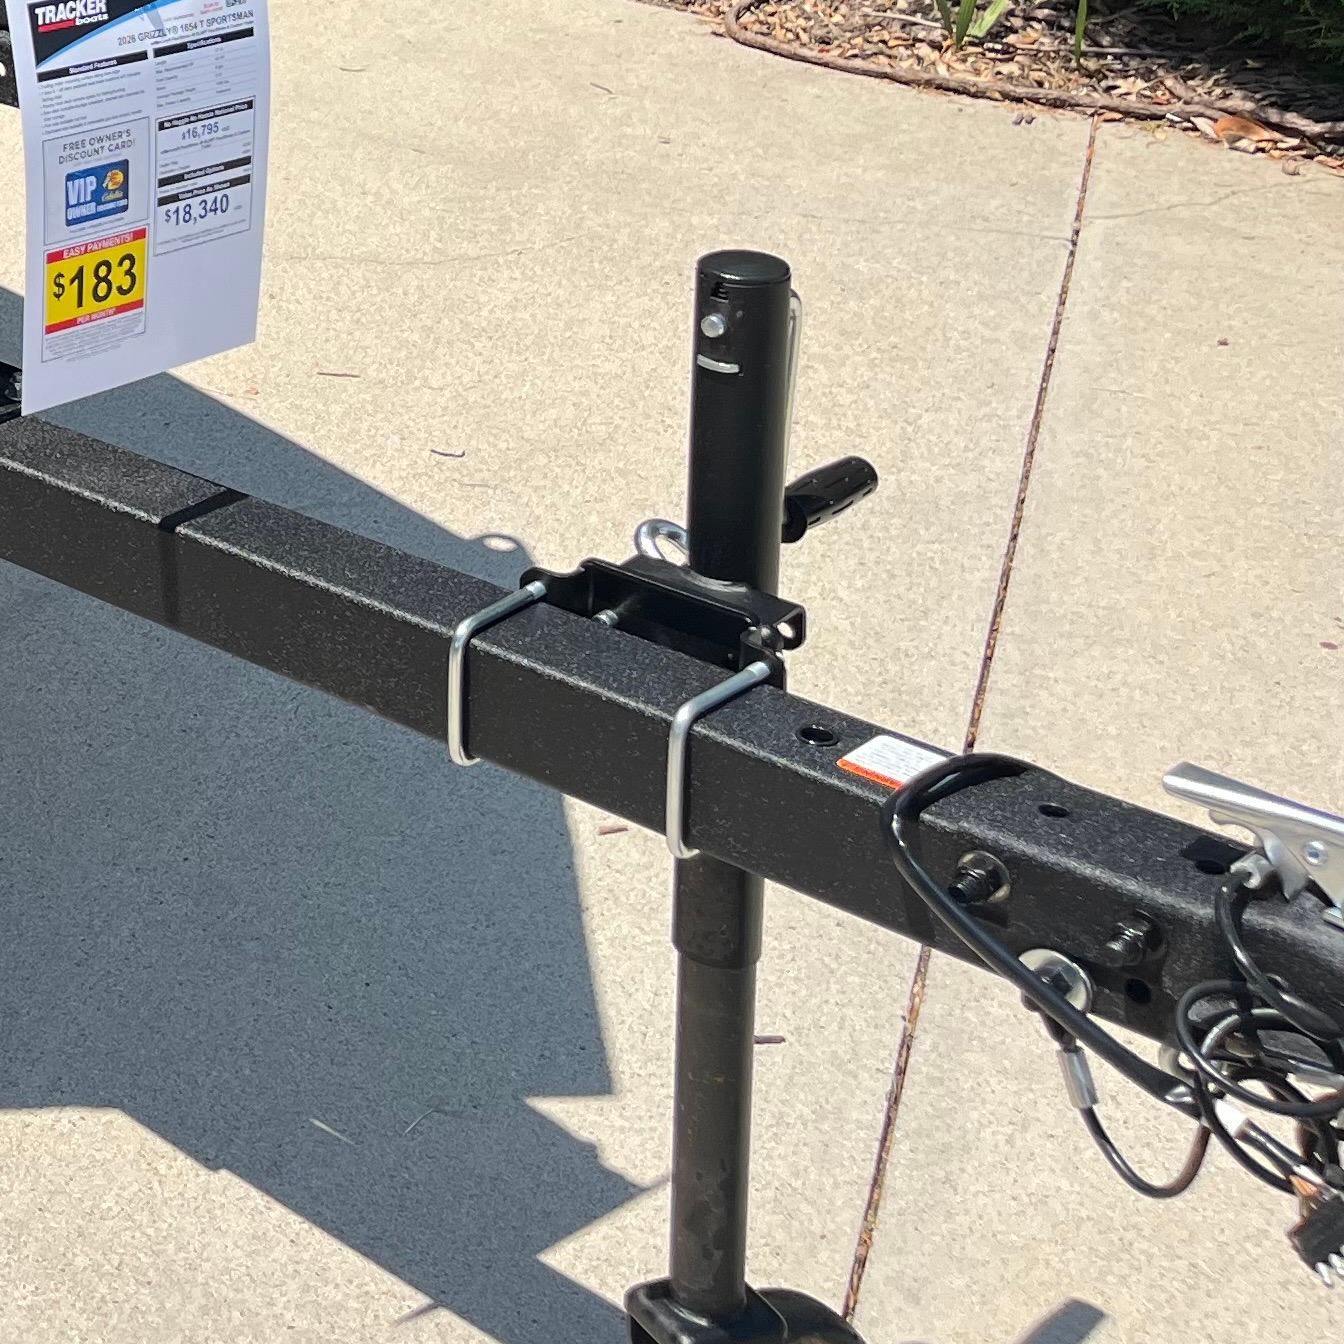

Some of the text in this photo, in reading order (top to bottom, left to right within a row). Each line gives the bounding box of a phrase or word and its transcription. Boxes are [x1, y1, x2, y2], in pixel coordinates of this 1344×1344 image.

[75, 12, 109, 26] boats
[206, 9, 255, 28] SPORTSMAN
[62, 128, 131, 153] FREE OWNER'S
[181, 121, 219, 141] $16,795
[58, 138, 136, 165] DISCOUNT CARD!
[67, 175, 97, 206] VIP
[66, 202, 97, 220] OWNER
[164, 193, 230, 227] $18,340
[62, 232, 134, 259] EASY PAYMENTS!
[52, 253, 137, 309] $183
